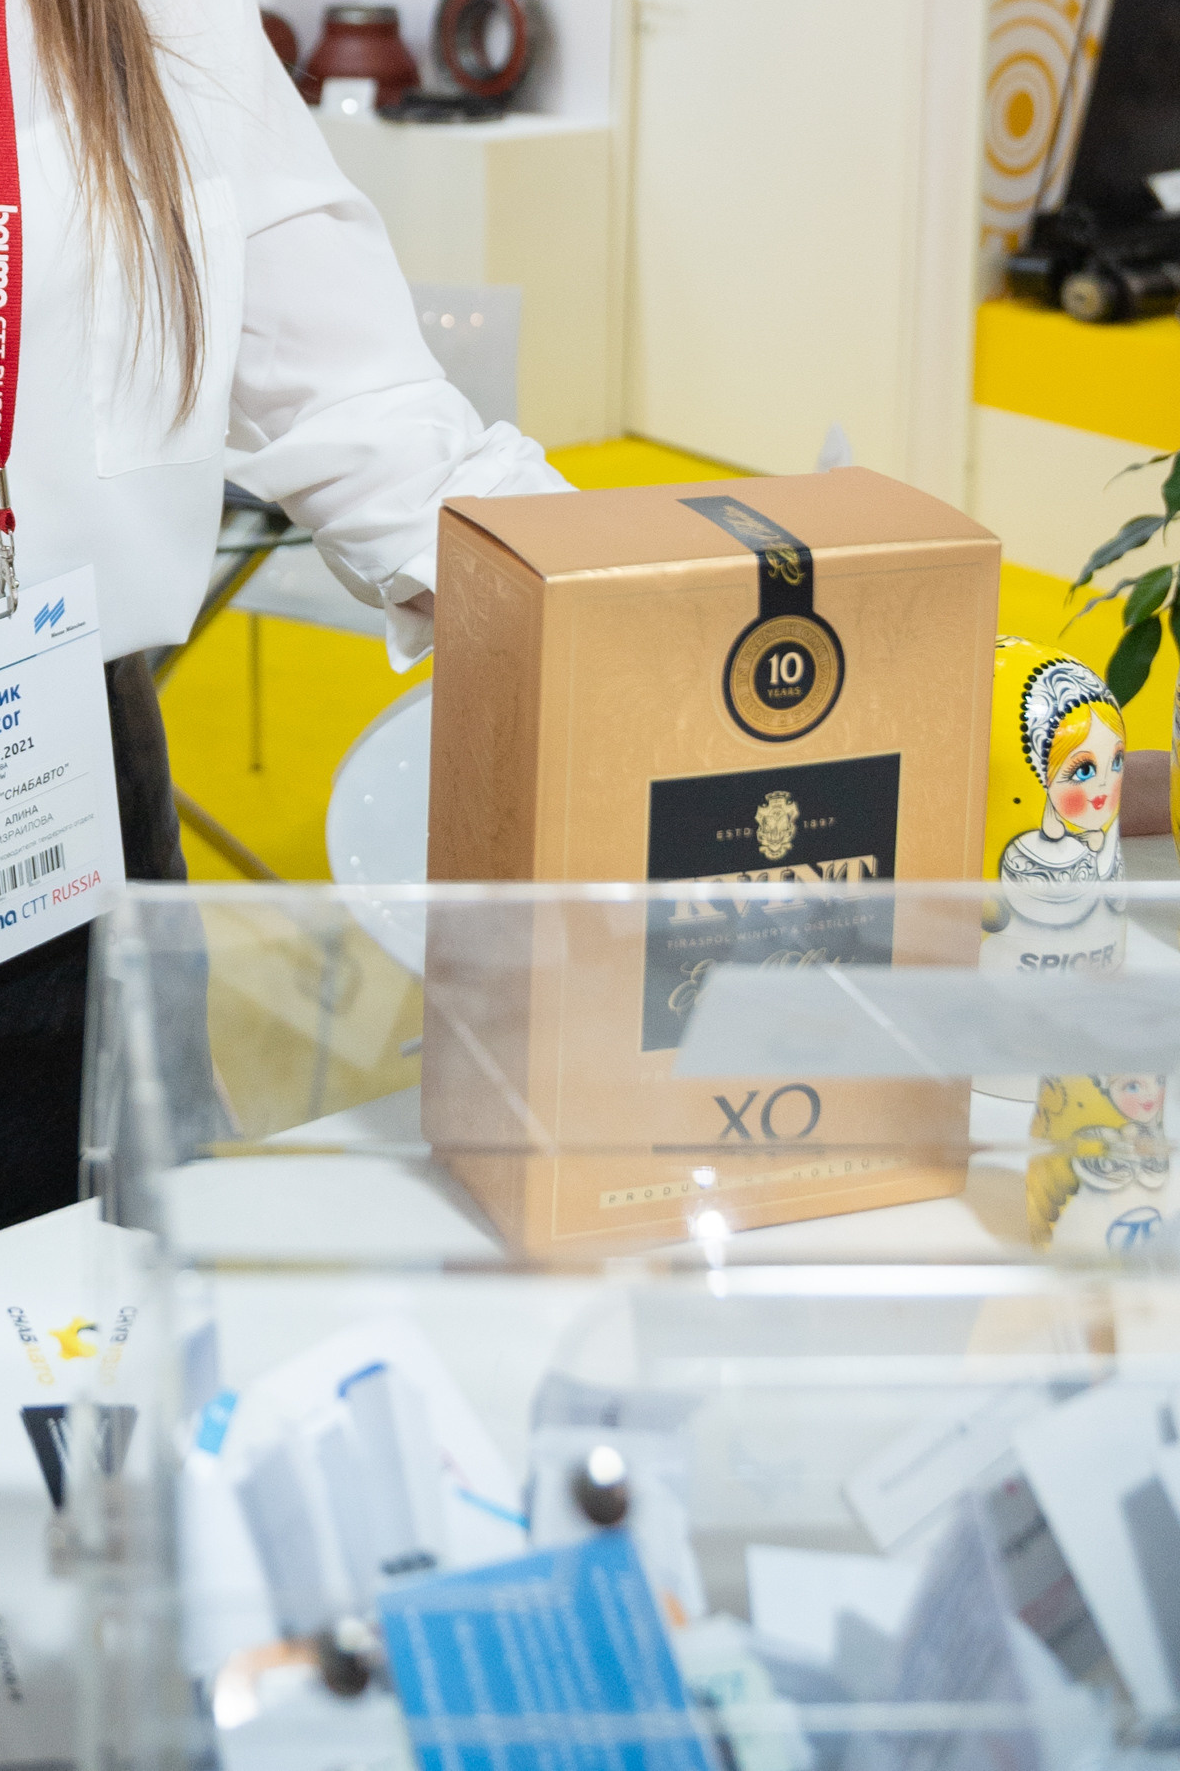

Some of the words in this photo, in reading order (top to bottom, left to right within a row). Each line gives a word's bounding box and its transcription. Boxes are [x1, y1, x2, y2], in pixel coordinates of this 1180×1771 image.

[768, 651, 805, 685] 10
[767, 686, 803, 698] YEARS
[0, 762, 70, 801] "СНАБАВТО"
[5, 804, 39, 827] АЛИНА
[803, 816, 836, 829] 1897
[716, 827, 751, 841] ESTD
[21, 893, 48, 919] CTT
[52, 869, 102, 906] RUSSIA
[712, 1082, 822, 1142] XO
